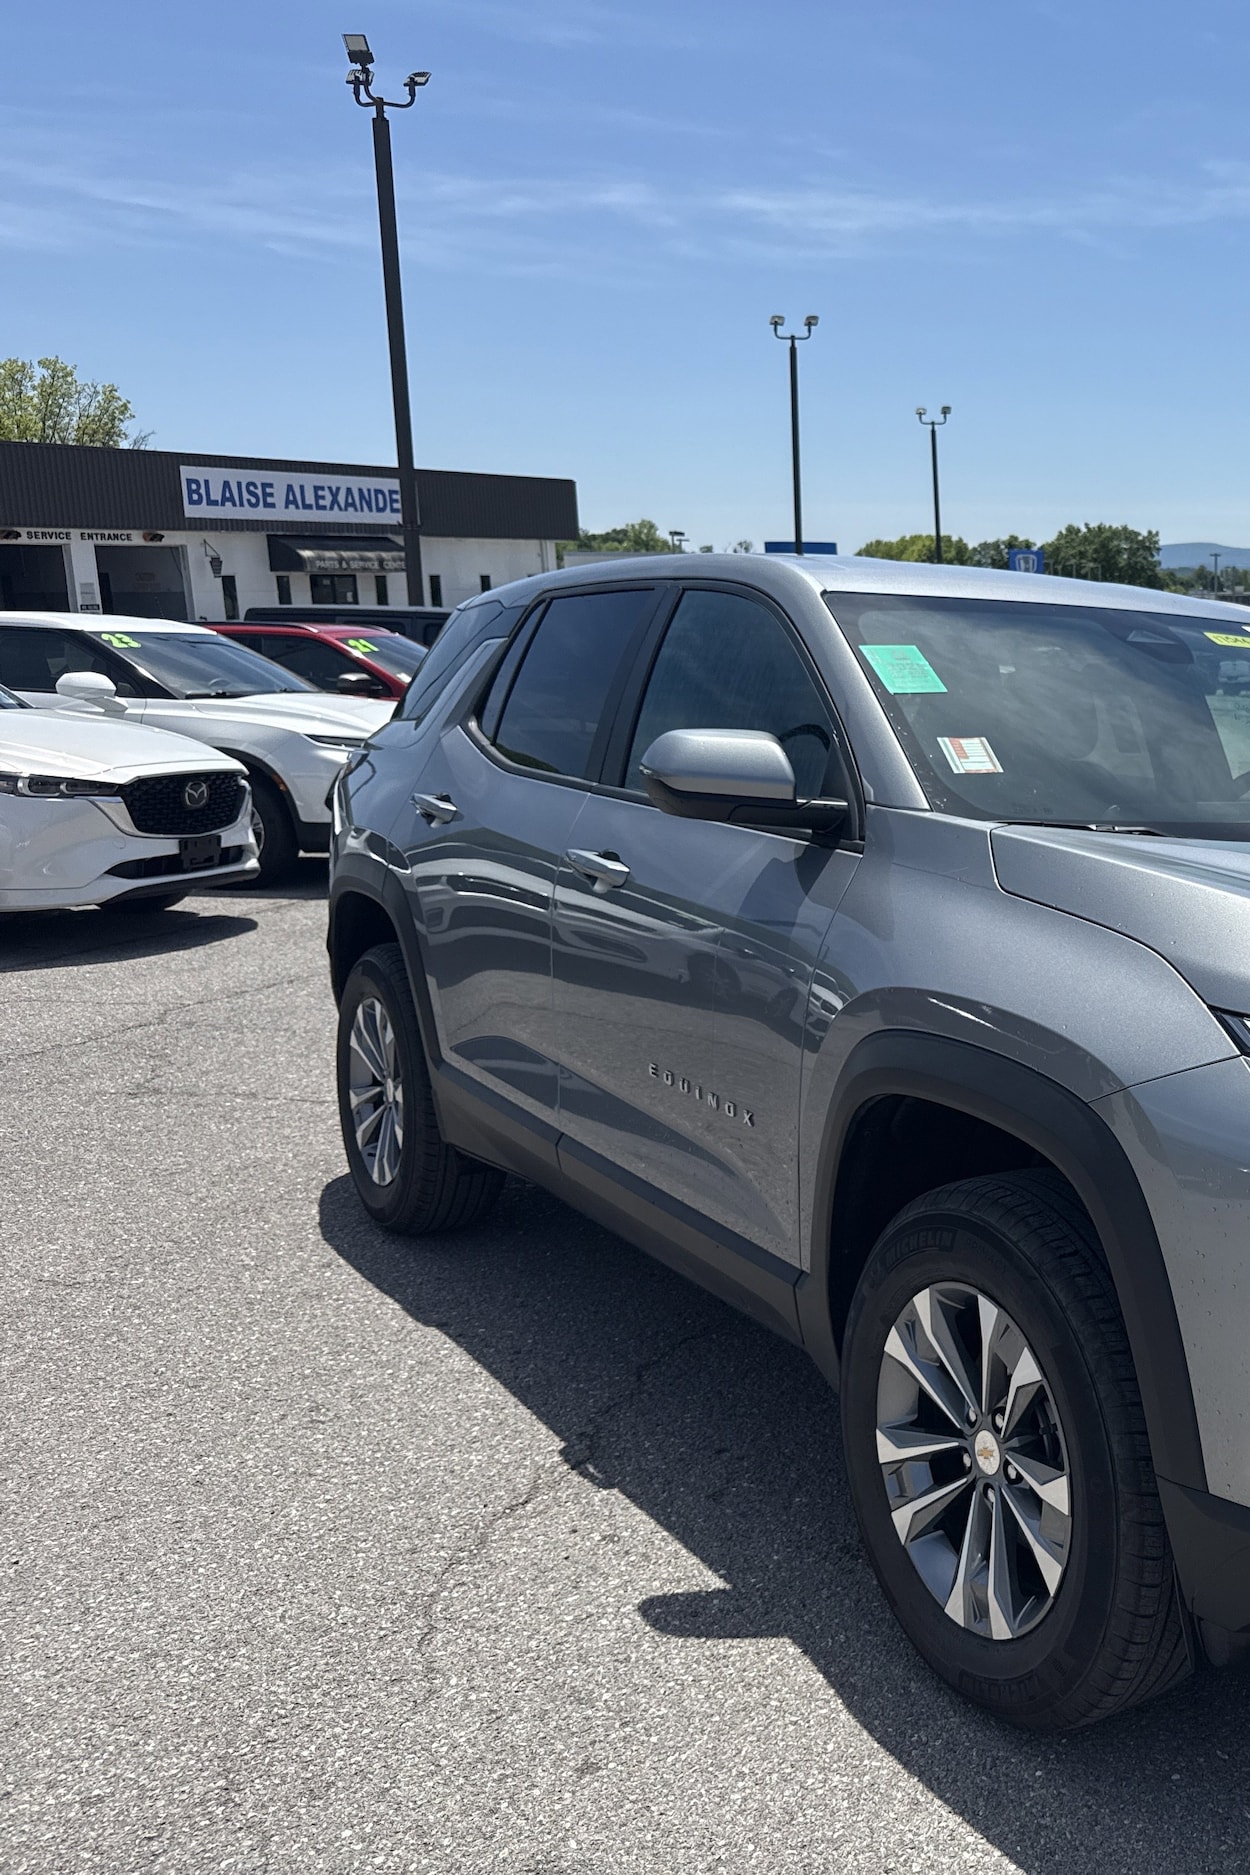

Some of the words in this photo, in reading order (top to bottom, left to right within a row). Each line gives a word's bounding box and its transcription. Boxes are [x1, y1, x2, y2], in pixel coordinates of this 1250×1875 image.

[185, 478, 277, 509] BLAISE
[284, 483, 402, 514] ALEXANDE
[26, 530, 72, 541] SERVICE
[80, 532, 133, 542] ENTRANCE
[315, 560, 340, 569] PARTS
[350, 560, 379, 570] SERVICE
[383, 561, 407, 570] CENTE
[100, 632, 142, 649] 23
[347, 638, 380, 653] 21
[647, 1062, 755, 1127] EQUINOX
[885, 1229, 955, 1268] MICHELIN
